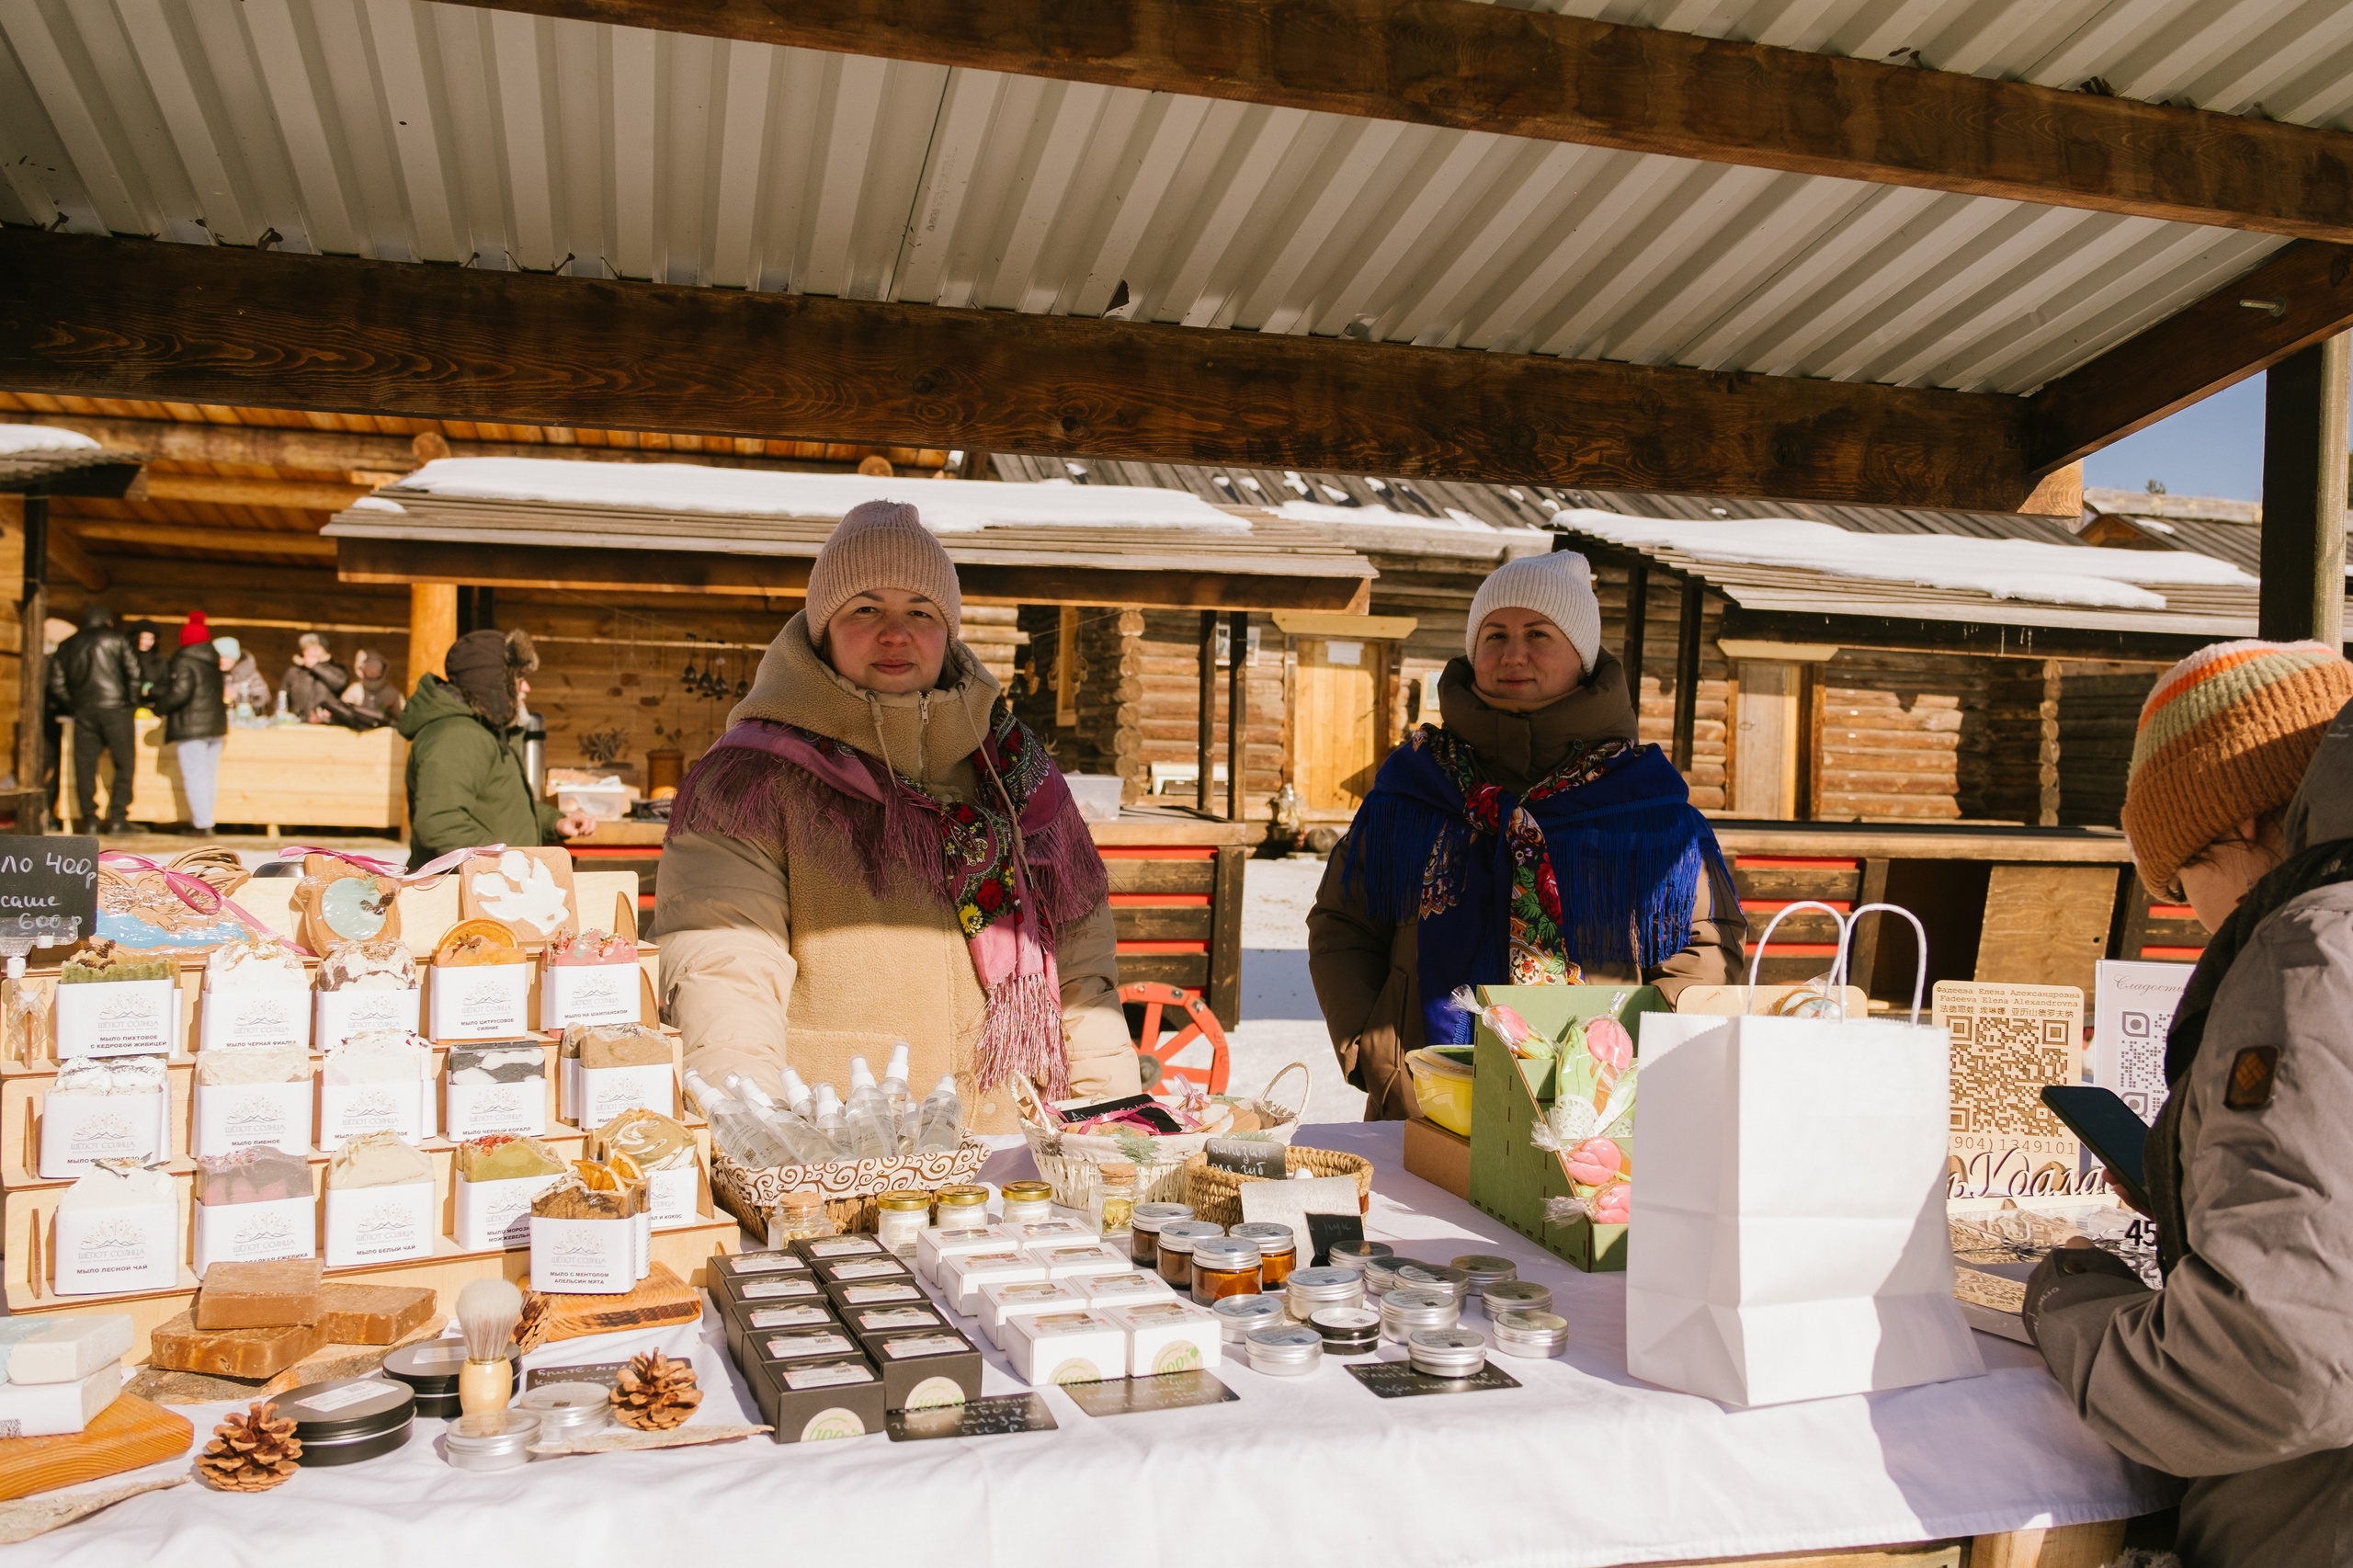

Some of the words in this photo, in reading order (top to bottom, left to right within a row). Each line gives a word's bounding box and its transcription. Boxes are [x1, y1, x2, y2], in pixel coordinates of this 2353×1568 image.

[18, 912, 62, 930] 600
[1936, 985, 1973, 994] Фадеева
[1978, 987, 2006, 995] Елена
[2010, 989, 2081, 999] Александровна
[1939, 994, 1977, 1004] Fadeeva
[1982, 996, 2009, 1005] Elena
[2013, 998, 2079, 1007] Alexandrovna
[590, 1009, 629, 1017] ШАМПАНСКОМ
[101, 1141, 136, 1149] СОЛНЦА
[488, 1233, 531, 1243] МОЖЖЕВЕЛЬН
[109, 1248, 146, 1258] СОЛНЦА
[378, 1245, 402, 1254] БЕЛЫЙ
[101, 1265, 131, 1273] ЛЕСНОЙ
